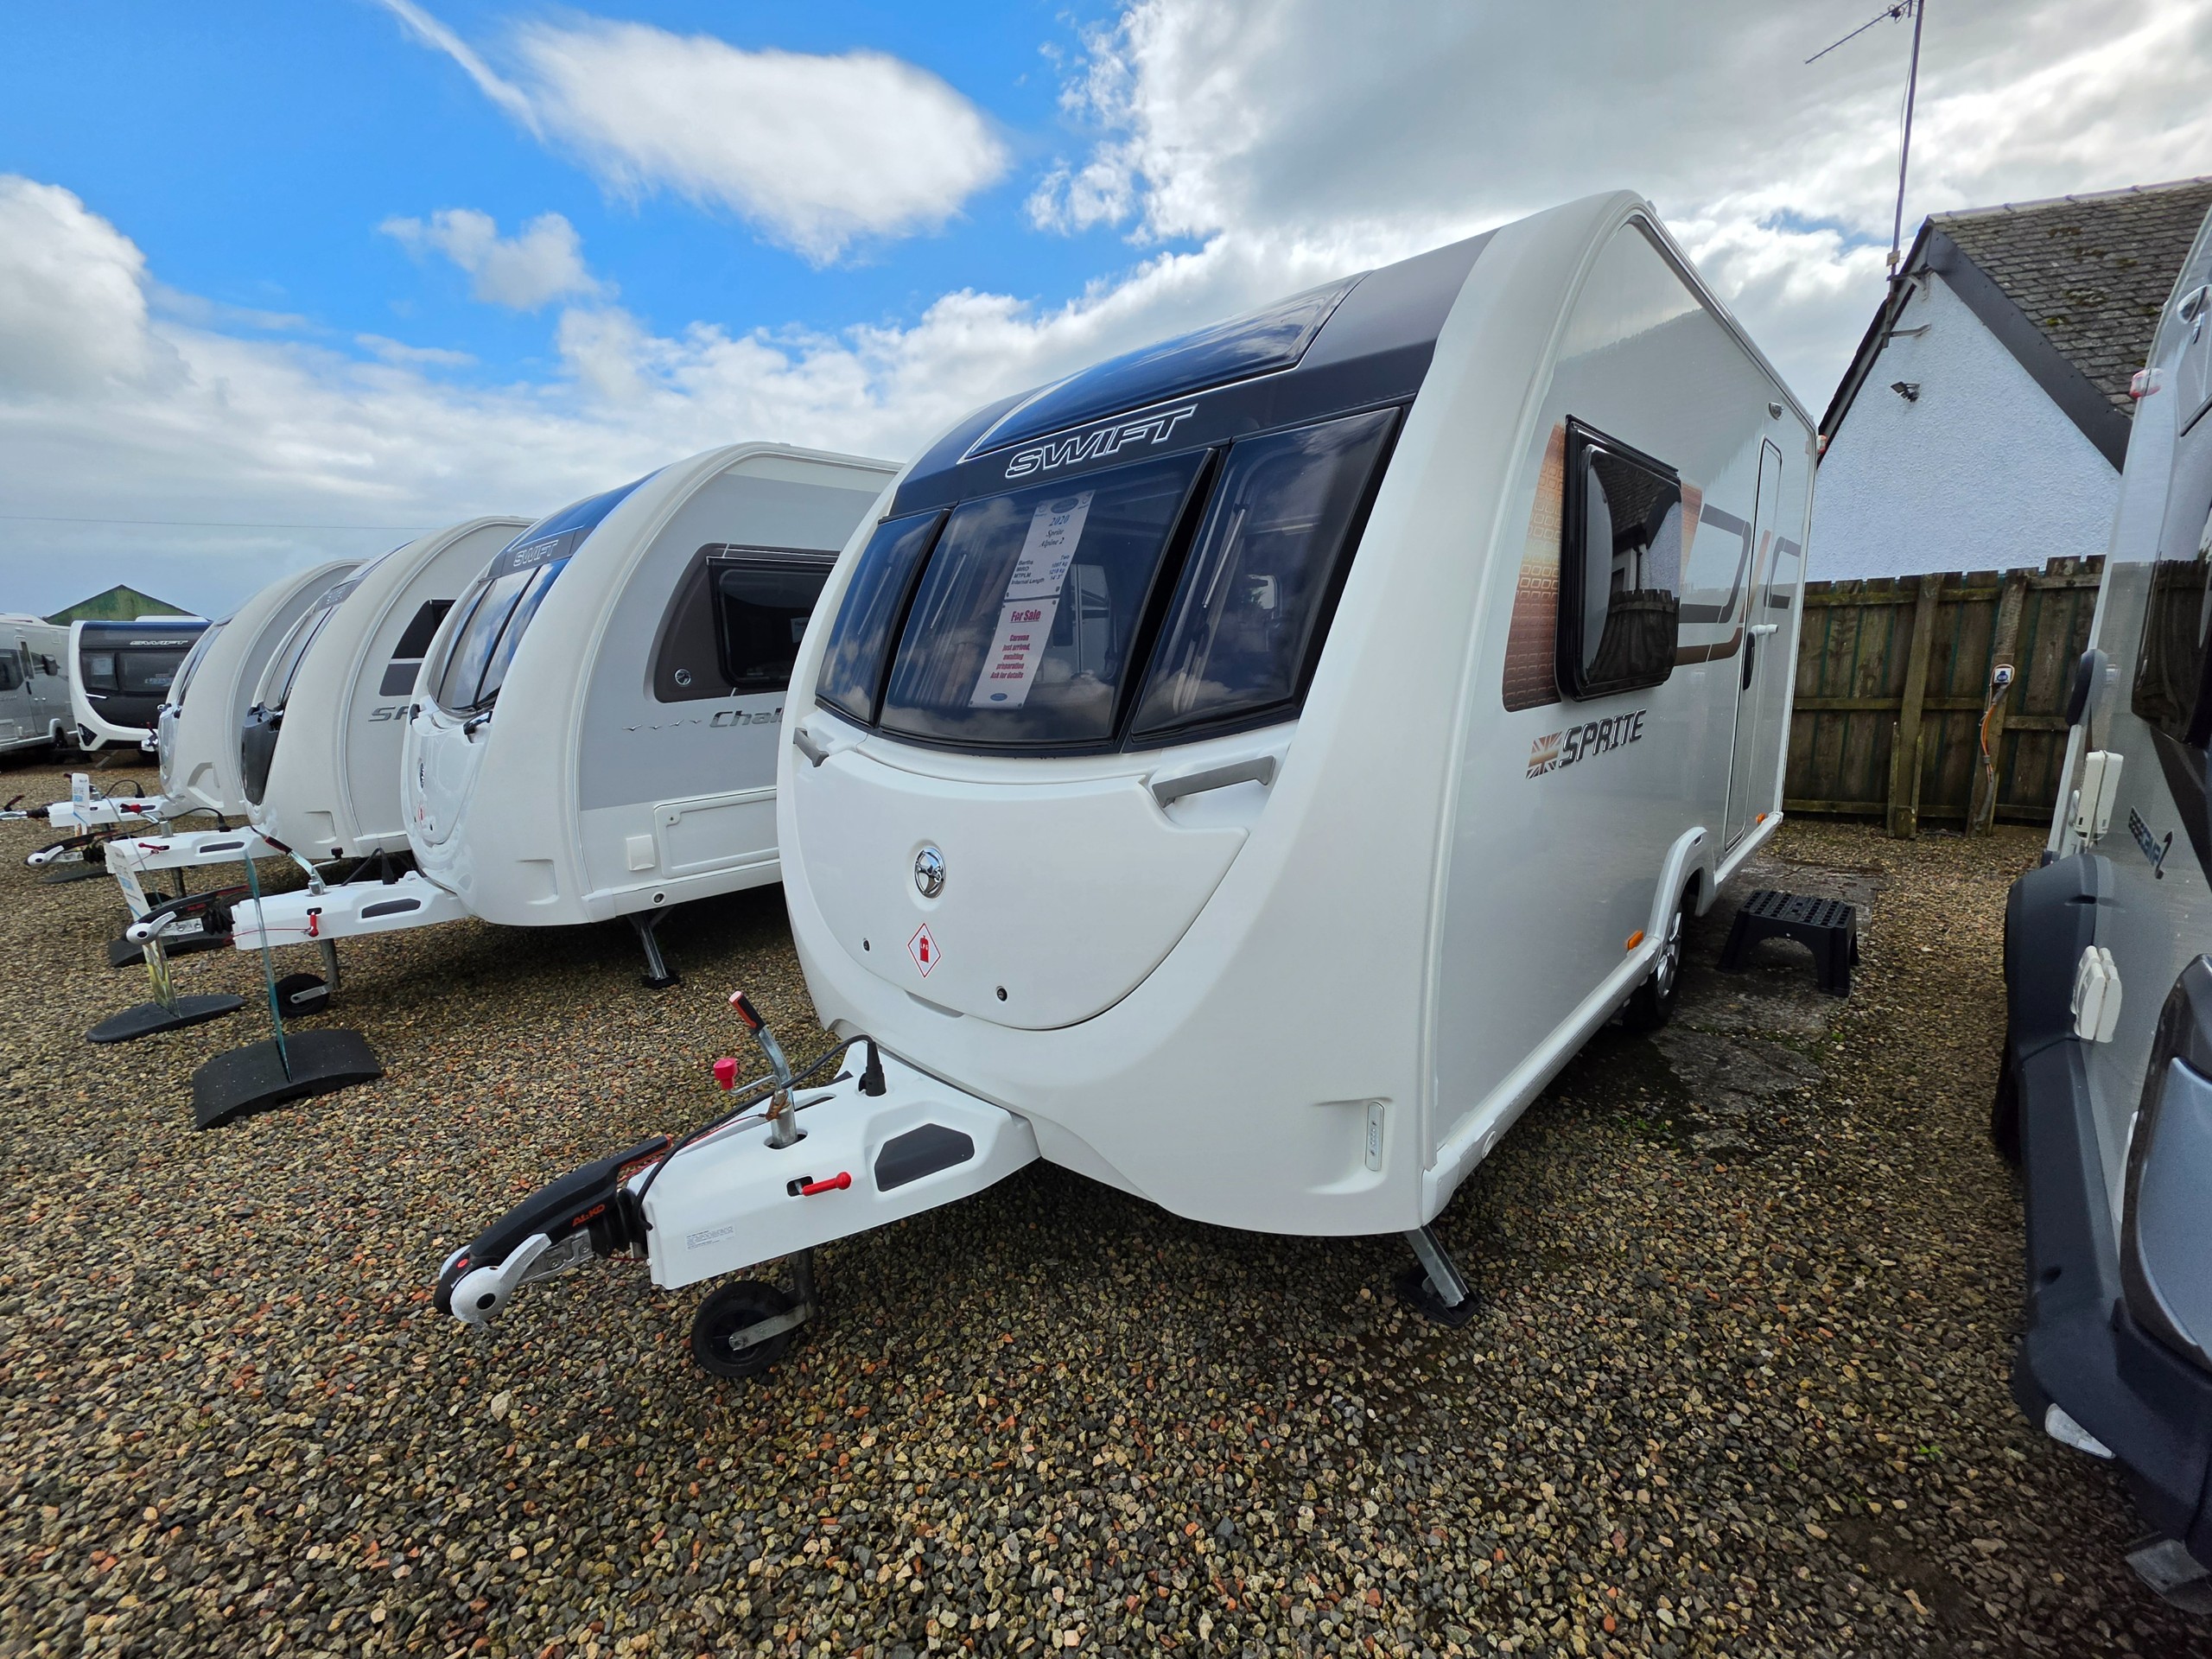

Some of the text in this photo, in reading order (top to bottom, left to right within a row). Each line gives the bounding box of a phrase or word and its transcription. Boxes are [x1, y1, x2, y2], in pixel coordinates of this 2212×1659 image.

[1005, 404, 1198, 479] SWIFT
[1048, 514, 1071, 526] 2020
[1046, 529, 1065, 538] Sprite
[513, 539, 559, 567] SWIFT
[1010, 608, 1041, 622] For Sale
[1558, 708, 1647, 768] SPRITE
